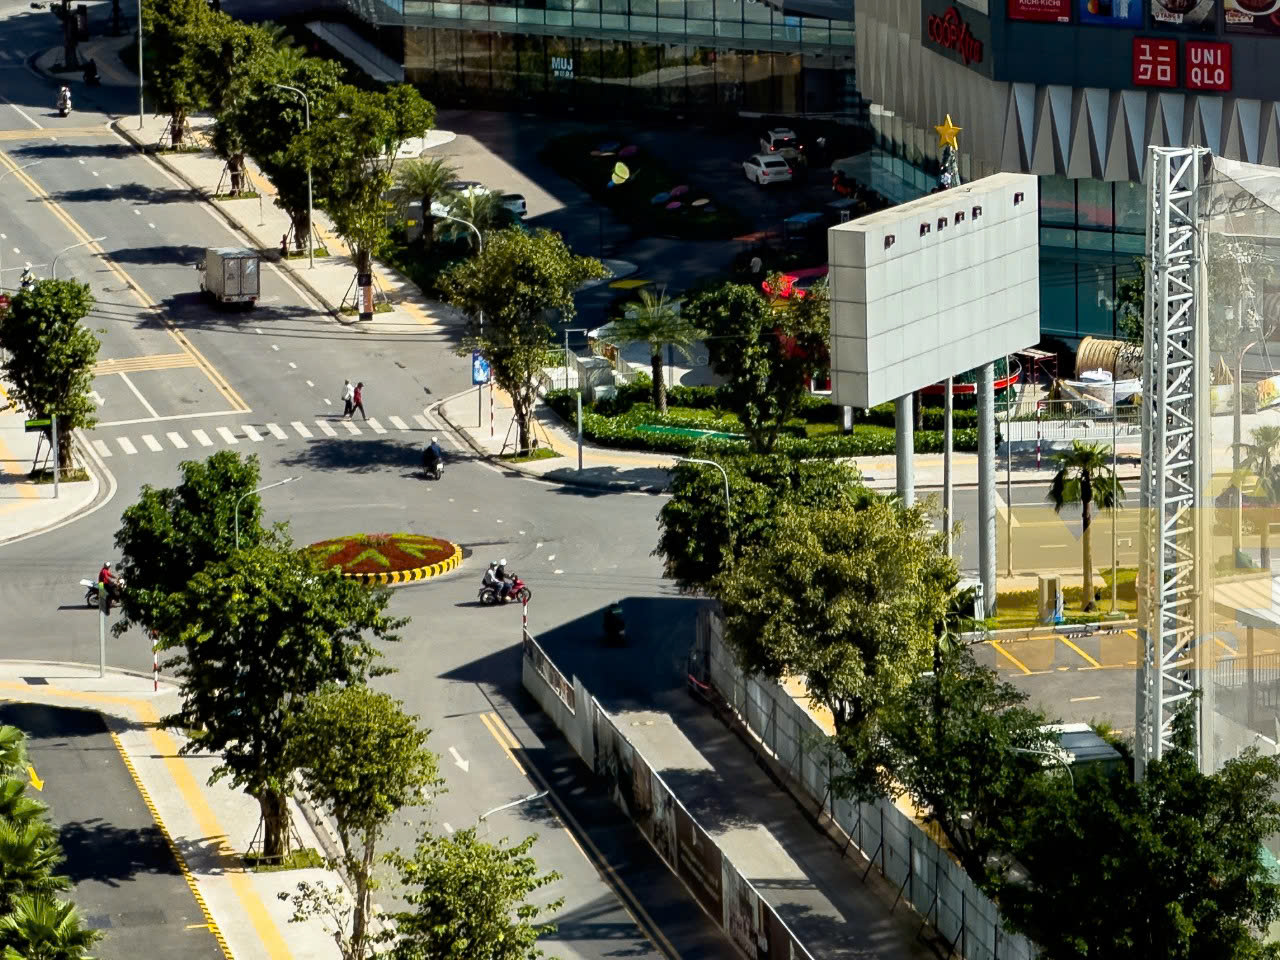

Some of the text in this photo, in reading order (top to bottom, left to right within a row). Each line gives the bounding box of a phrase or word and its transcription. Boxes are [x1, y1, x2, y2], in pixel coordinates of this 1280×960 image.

[551, 56, 574, 71] MUJ
[1191, 48, 1222, 65] UNI
[1191, 67, 1225, 87] QLO
